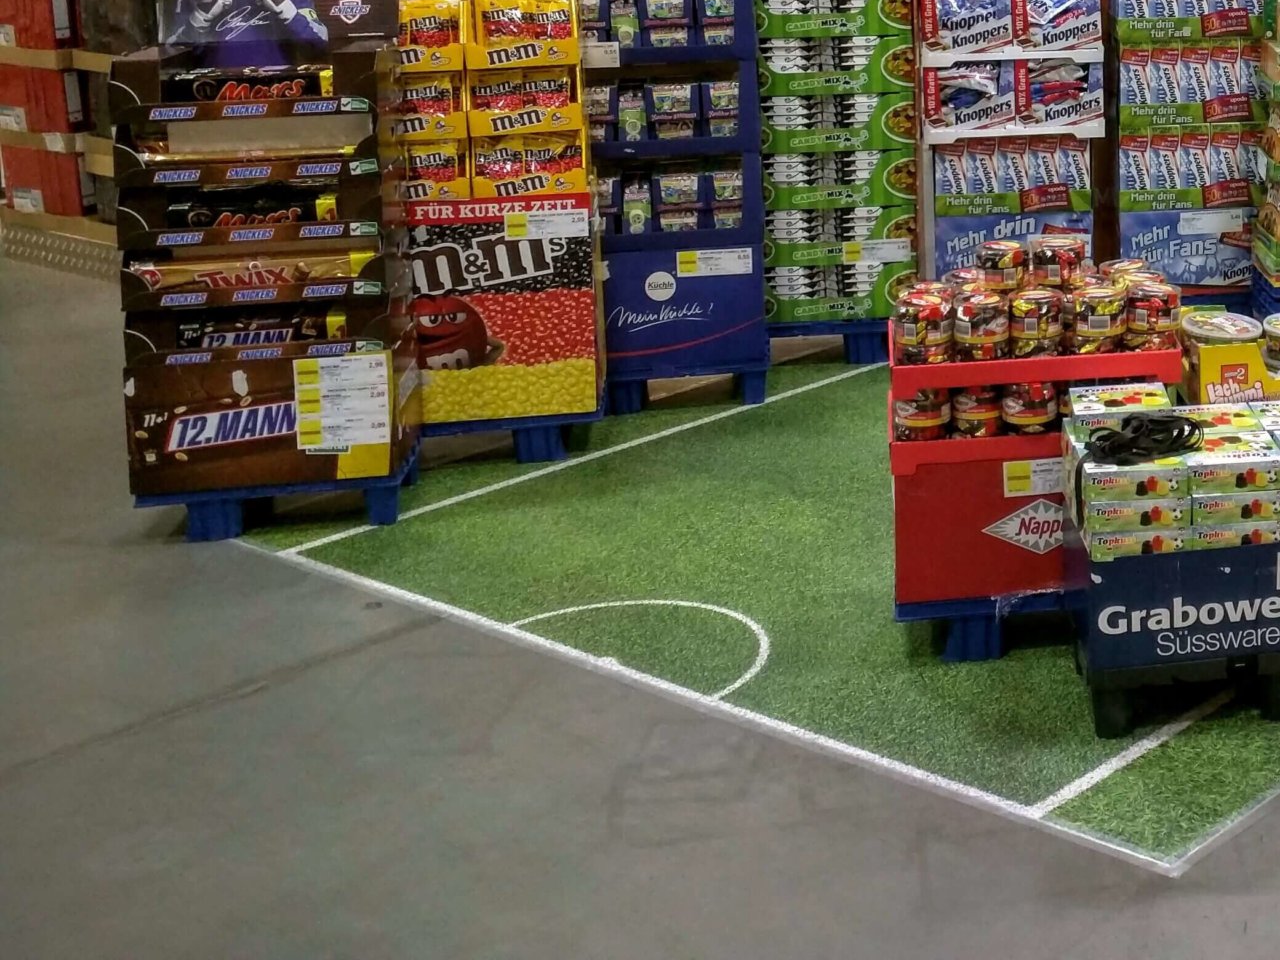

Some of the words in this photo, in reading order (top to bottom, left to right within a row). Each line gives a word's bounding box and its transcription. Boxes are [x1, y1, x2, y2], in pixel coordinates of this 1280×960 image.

[821, 19, 837, 27] MIX
[1129, 20, 1153, 29] Mehr
[1156, 19, 1175, 28] drin
[952, 22, 1009, 49] Knoppers
[1042, 19, 1098, 46] Knoppers
[1151, 27, 1166, 37] für
[1168, 27, 1191, 37] Fan
[487, 42, 544, 66] m&m's
[824, 76, 841, 85] MIX
[927, 71, 936, 94] Gratis
[1018, 68, 1026, 91] Gratis
[216, 79, 306, 101] Mars
[150, 107, 196, 119] SNICKERS
[223, 104, 267, 117] SNICKERS
[293, 101, 338, 113] SNICKERS
[954, 99, 1012, 125] Knoppers
[1044, 96, 1101, 122] Knoppers
[1131, 106, 1154, 116] Mehr
[1158, 106, 1176, 115] drin
[491, 109, 547, 132] m&m's
[1152, 115, 1167, 124] für
[1170, 114, 1193, 124] Fans
[825, 134, 841, 142] MIX
[227, 167, 271, 179] SNICKERS
[298, 163, 341, 175] SNICKERS
[154, 170, 200, 182] SNICKERS
[495, 175, 550, 197] m&m's
[827, 190, 843, 198] MIX
[1131, 192, 1154, 202] Mehr
[1157, 192, 1176, 201] drin
[946, 196, 971, 205] Mehr
[973, 196, 992, 204] drin
[1152, 200, 1166, 210] für
[1169, 200, 1193, 209] Fans
[414, 201, 455, 220] FÜR
[458, 202, 525, 218] KURZE
[530, 198, 576, 212] ZEIT
[968, 205, 983, 214] für
[986, 205, 1010, 213] Fans
[946, 229, 987, 255] Mehr
[993, 215, 1036, 240] drin
[1131, 224, 1171, 251] Mehr
[1169, 238, 1218, 258] Fans
[411, 237, 567, 294] m&ms
[1222, 264, 1250, 281] Knopp
[647, 280, 675, 289] Küchle
